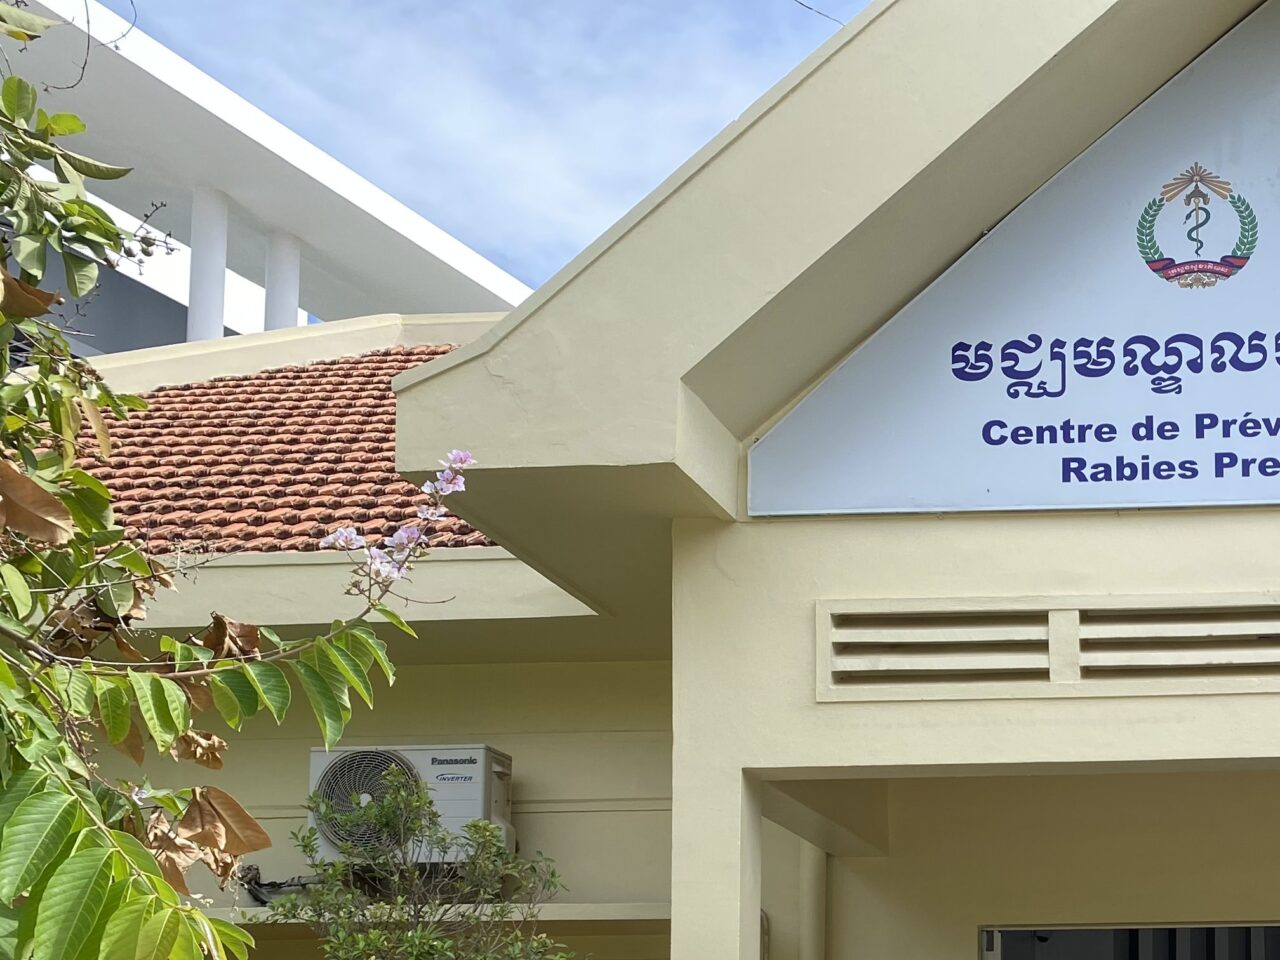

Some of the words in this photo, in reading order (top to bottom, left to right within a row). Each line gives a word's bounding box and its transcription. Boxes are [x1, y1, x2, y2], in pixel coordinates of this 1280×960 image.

[981, 418, 1117, 446] Centre
[1131, 415, 1180, 442] de
[1061, 454, 1199, 483] Rabies
[431, 757, 478, 765] Panasonic
